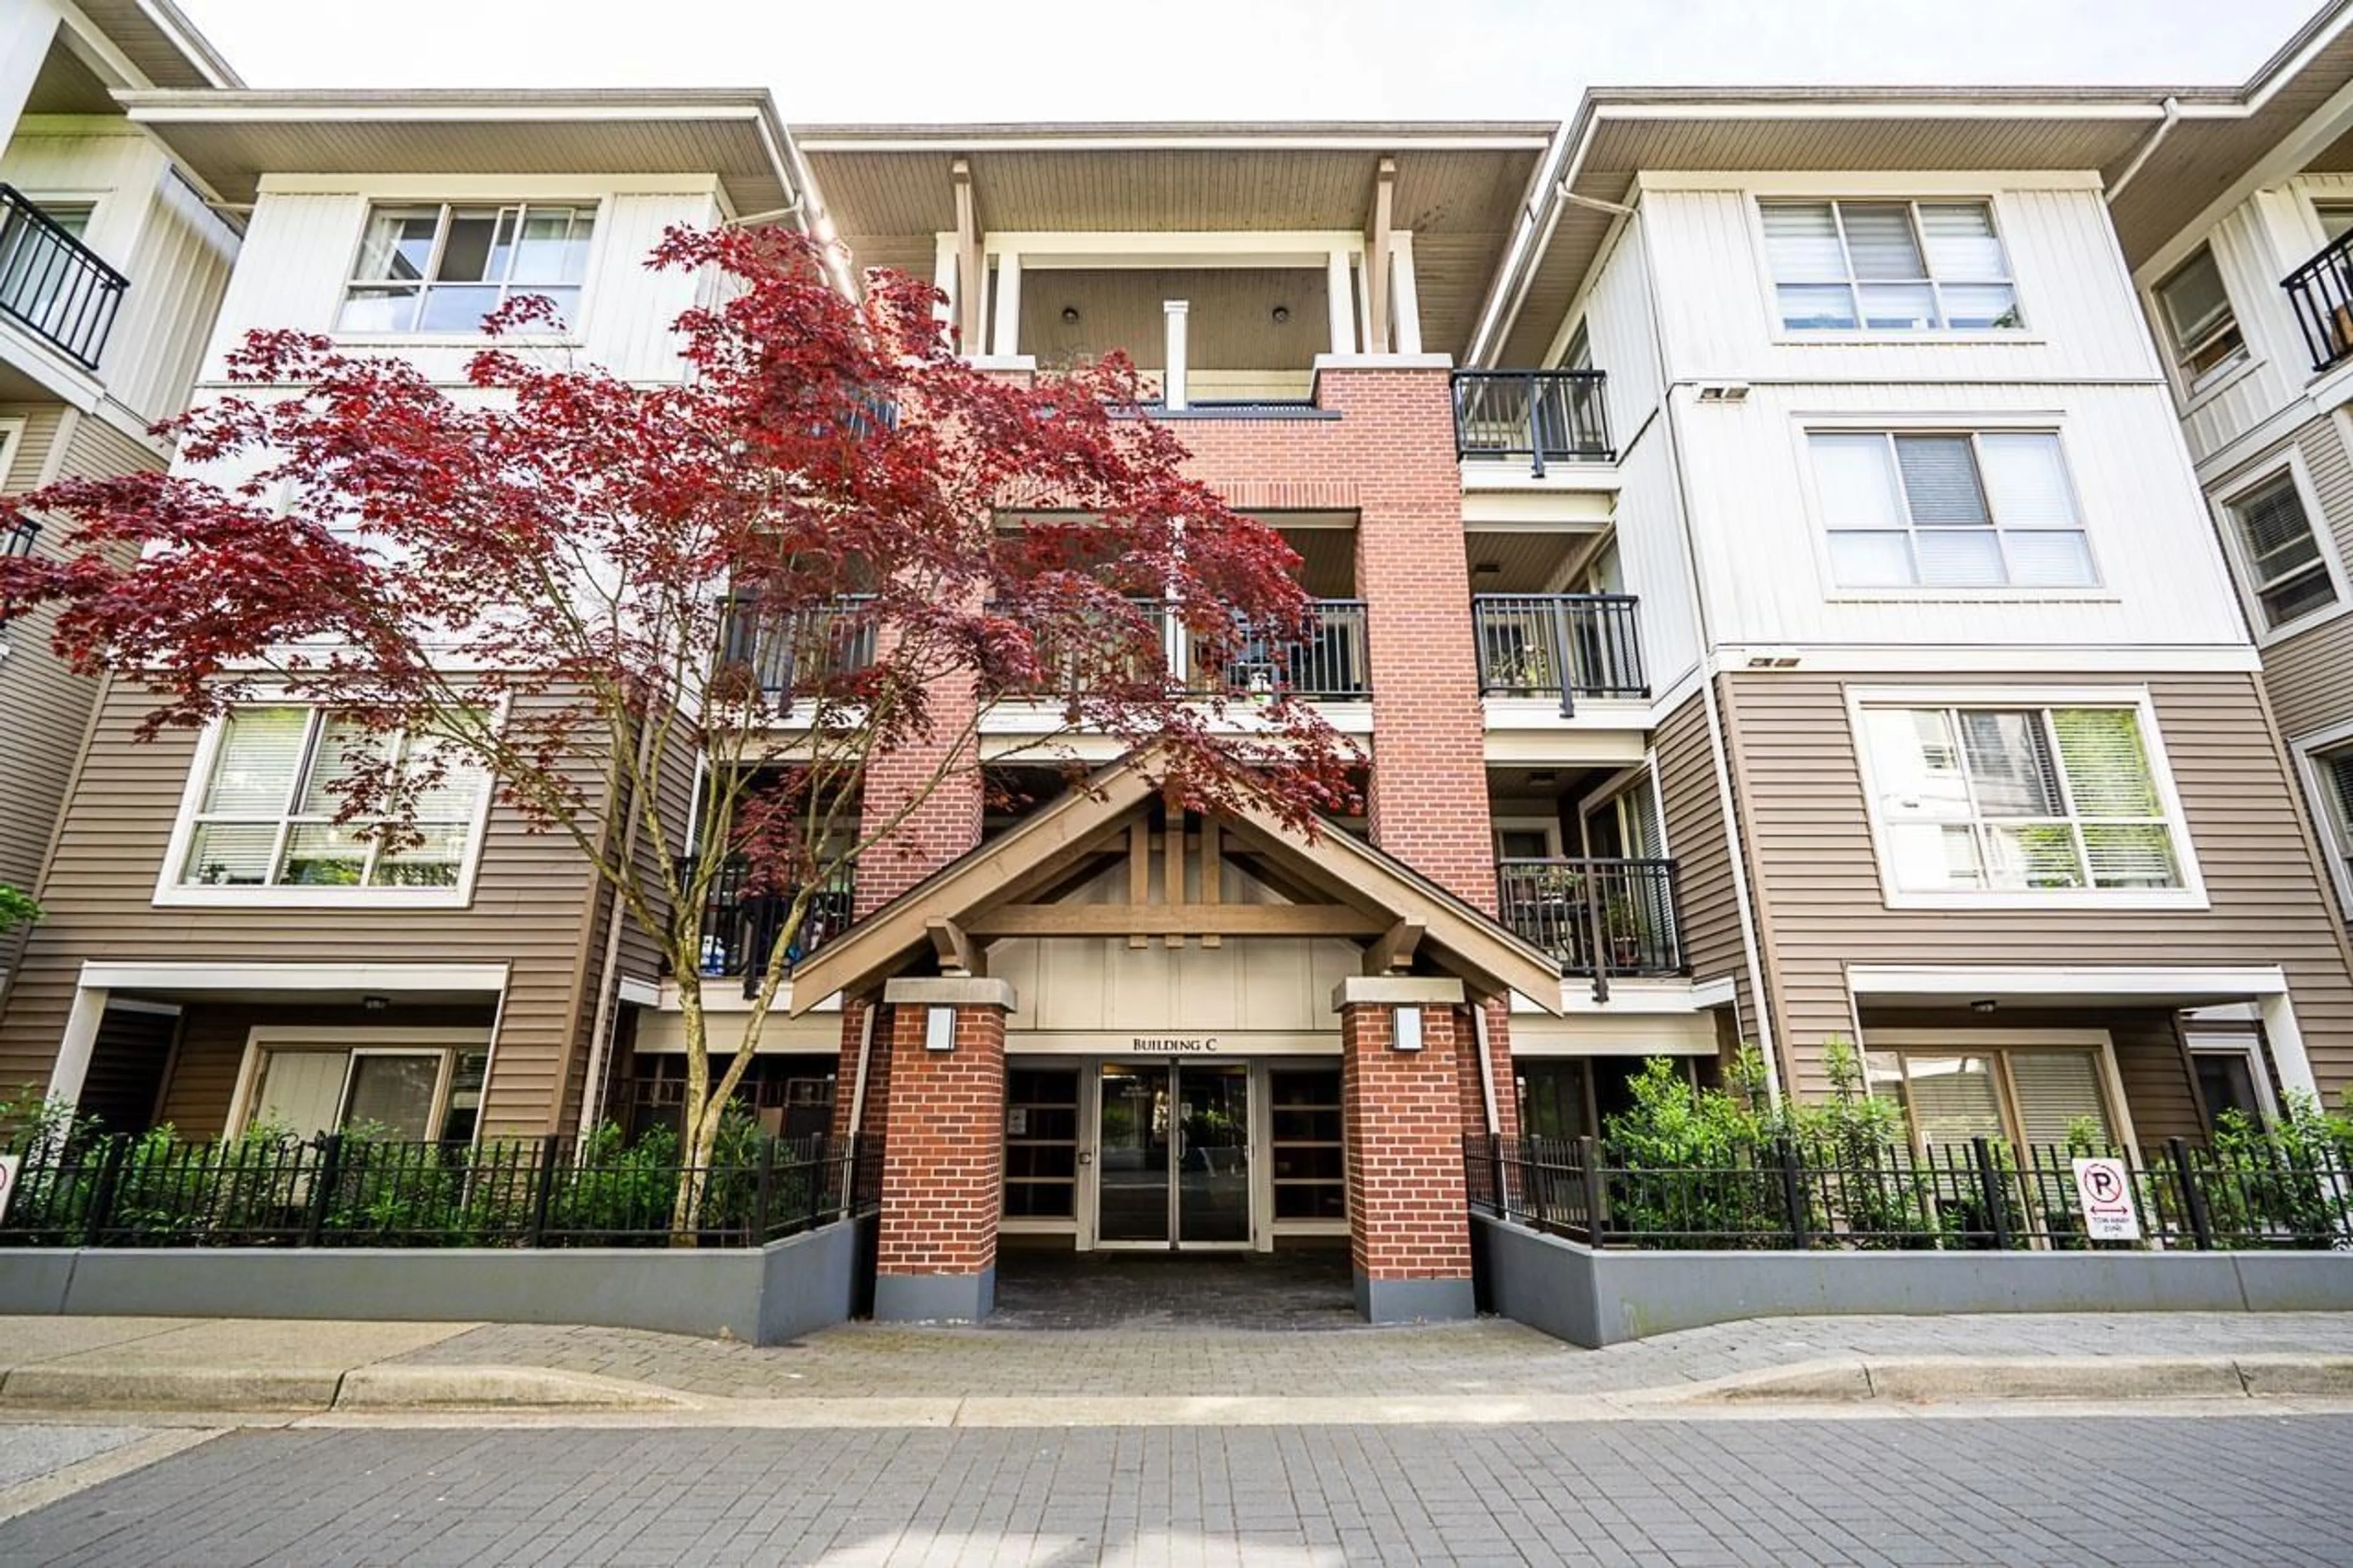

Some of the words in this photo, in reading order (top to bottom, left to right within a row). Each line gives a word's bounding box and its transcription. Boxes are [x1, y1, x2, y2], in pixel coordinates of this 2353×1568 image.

[1133, 1039, 1200, 1050] BUILDING
[1205, 1038, 1217, 1051] C
[2093, 1172, 2111, 1195] P
